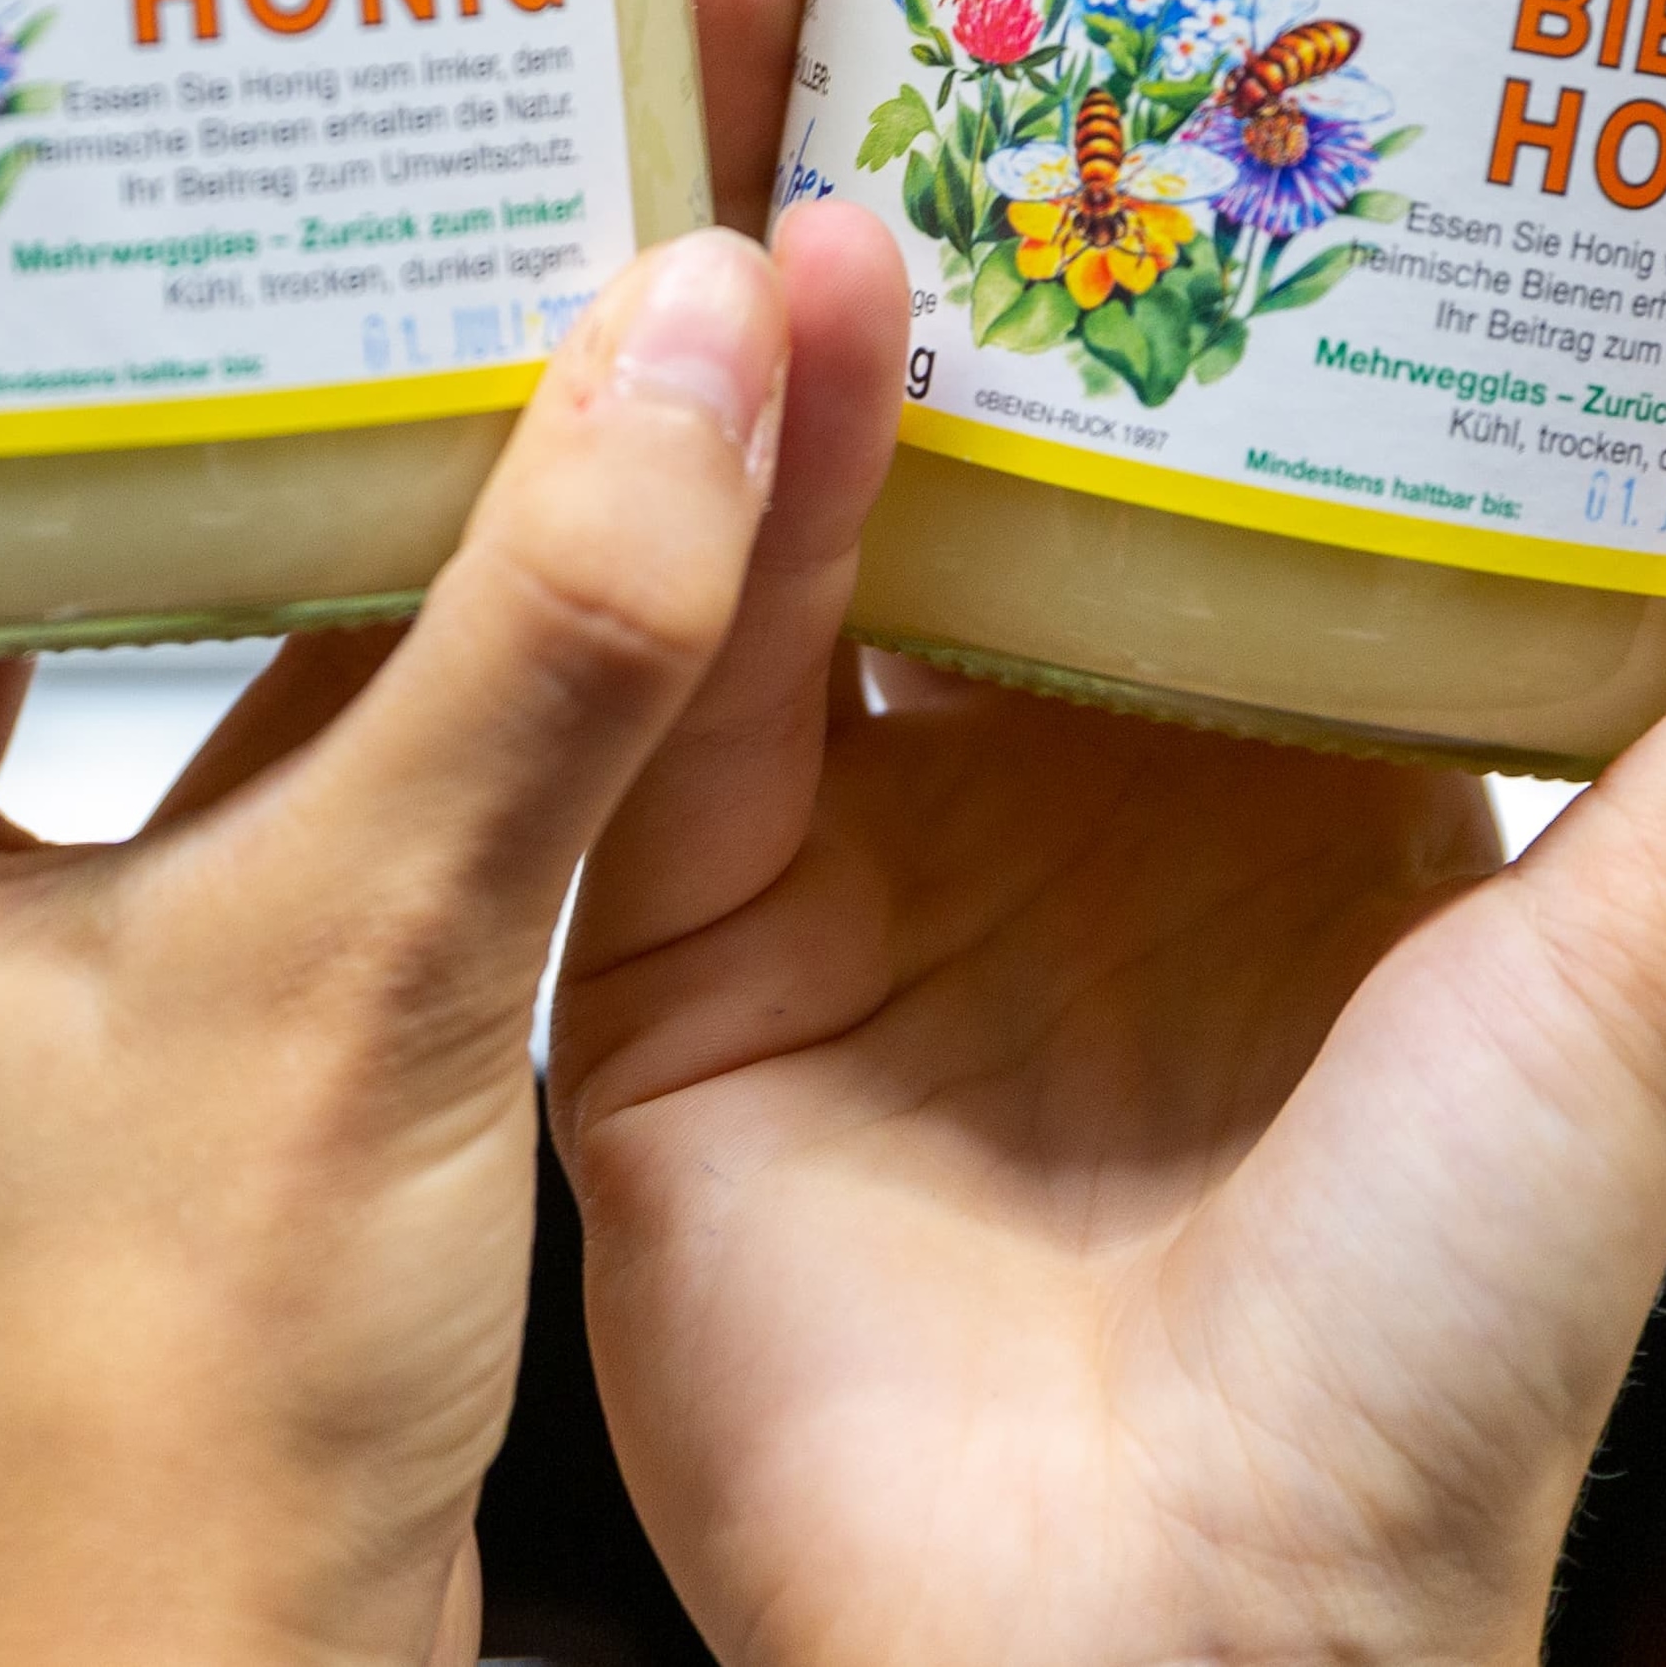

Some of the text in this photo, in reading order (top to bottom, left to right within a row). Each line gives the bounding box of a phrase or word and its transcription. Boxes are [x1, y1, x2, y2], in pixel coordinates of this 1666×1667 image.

[62, 79, 168, 120] Essen
[175, 70, 231, 108] Sie
[239, 63, 338, 108] Honig
[347, 63, 413, 98] vom
[513, 43, 573, 76] denn
[198, 116, 317, 155] Bienen
[324, 104, 445, 142] erhalten
[453, 93, 497, 128] die
[121, 168, 167, 206] Ihr
[174, 158, 298, 206] Beitrag
[304, 153, 377, 192] zum
[12, 225, 261, 275] Mehrwegglas
[298, 210, 419, 255] Zurück
[430, 203, 495, 240] zum
[1407, 200, 1503, 247] Essen
[1511, 220, 1560, 258] Sie
[1571, 230, 1654, 280] Honig
[163, 269, 250, 313] Kühl,
[401, 243, 500, 293] dunkel
[1348, 240, 1511, 296] heimische
[1522, 271, 1624, 314] Bienen
[1435, 300, 1478, 334] Ihr
[1486, 309, 1594, 362] Beitrag
[1604, 332, 1663, 367] zum
[1314, 337, 1549, 409] Mehrwegglas
[1448, 409, 1527, 453] Kühl,
[1537, 425, 1650, 472] trocken,
[1245, 448, 1523, 520] Mindestens haltbar bis:
